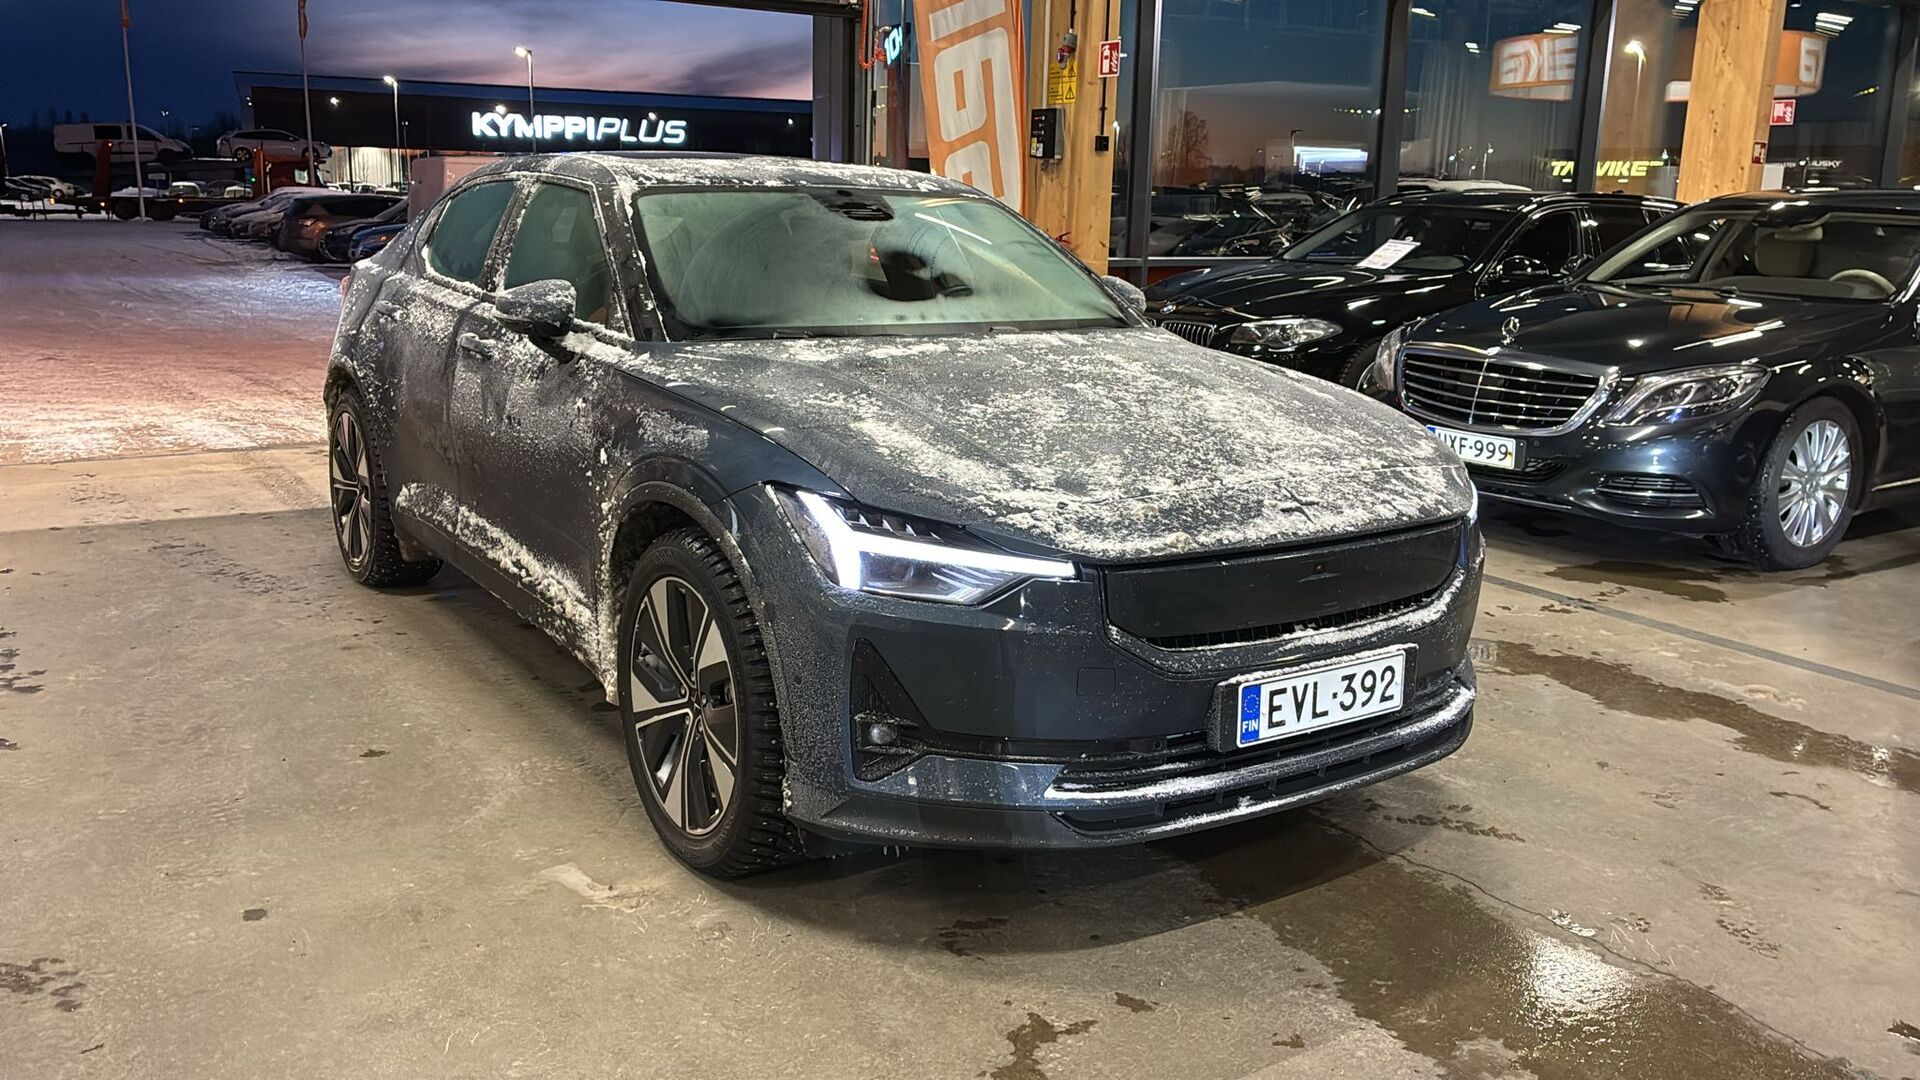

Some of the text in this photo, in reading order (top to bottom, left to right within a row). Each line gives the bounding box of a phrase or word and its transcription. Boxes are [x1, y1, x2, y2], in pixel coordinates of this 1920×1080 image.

[471, 111, 687, 144] KYMPPIPLUS
[1551, 160, 1649, 176] TAVIKE
[1267, 665, 1396, 730] EVL-392
[1242, 718, 1259, 734] FIN
